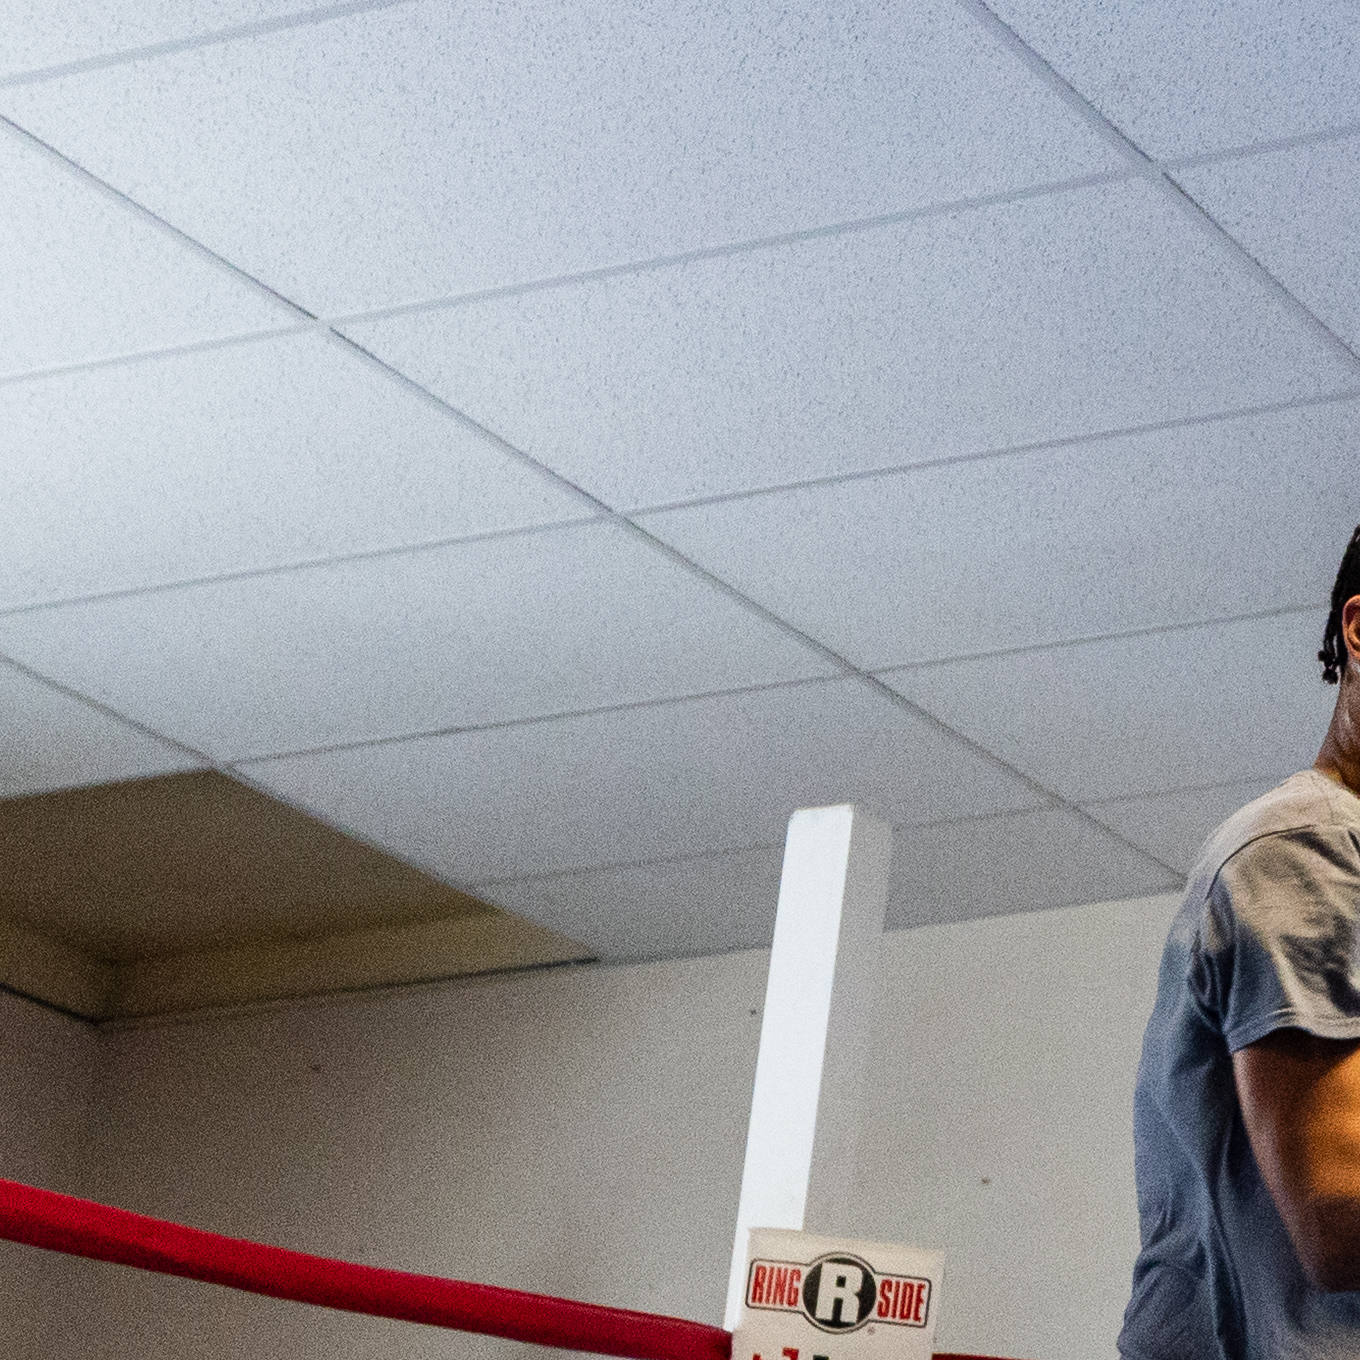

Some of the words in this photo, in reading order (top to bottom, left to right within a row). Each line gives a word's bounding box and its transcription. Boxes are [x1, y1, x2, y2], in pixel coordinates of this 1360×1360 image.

[751, 1265, 801, 1307] RING
[815, 1262, 863, 1324] R
[877, 1278, 926, 1322] SIDE
